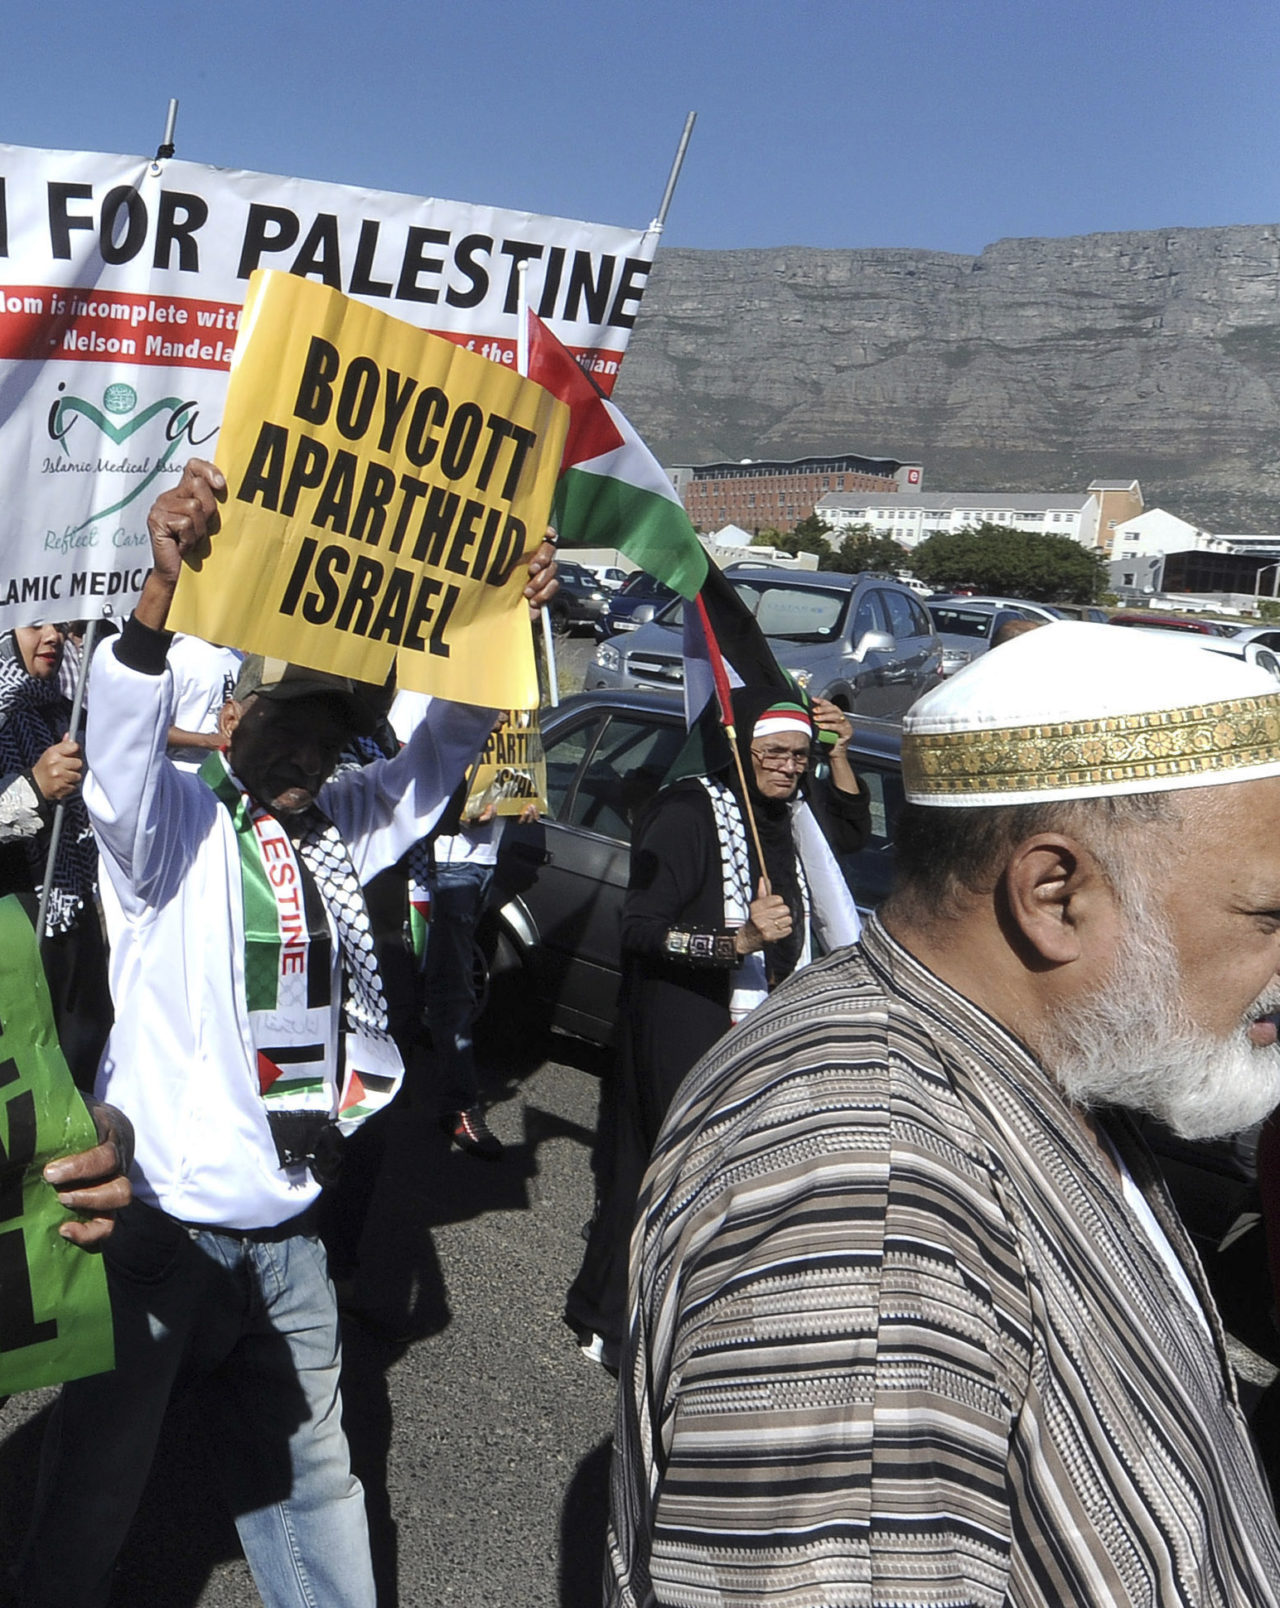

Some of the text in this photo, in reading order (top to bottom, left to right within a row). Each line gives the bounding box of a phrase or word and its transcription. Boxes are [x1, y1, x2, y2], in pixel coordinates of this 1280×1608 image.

[47, 181, 208, 273] FOR
[236, 203, 652, 329] PALESTINE
[50, 293, 66, 315] is
[70, 295, 188, 327] incomplete
[63, 329, 135, 354] Nelson
[144, 334, 234, 363] Mandela
[293, 335, 537, 502] BOYCOTT
[41, 456, 92, 474] Islamic
[92, 457, 149, 474] Medical
[112, 527, 147, 547] Care
[236, 421, 527, 588] APARTHEID
[279, 536, 462, 659] ISRAEL
